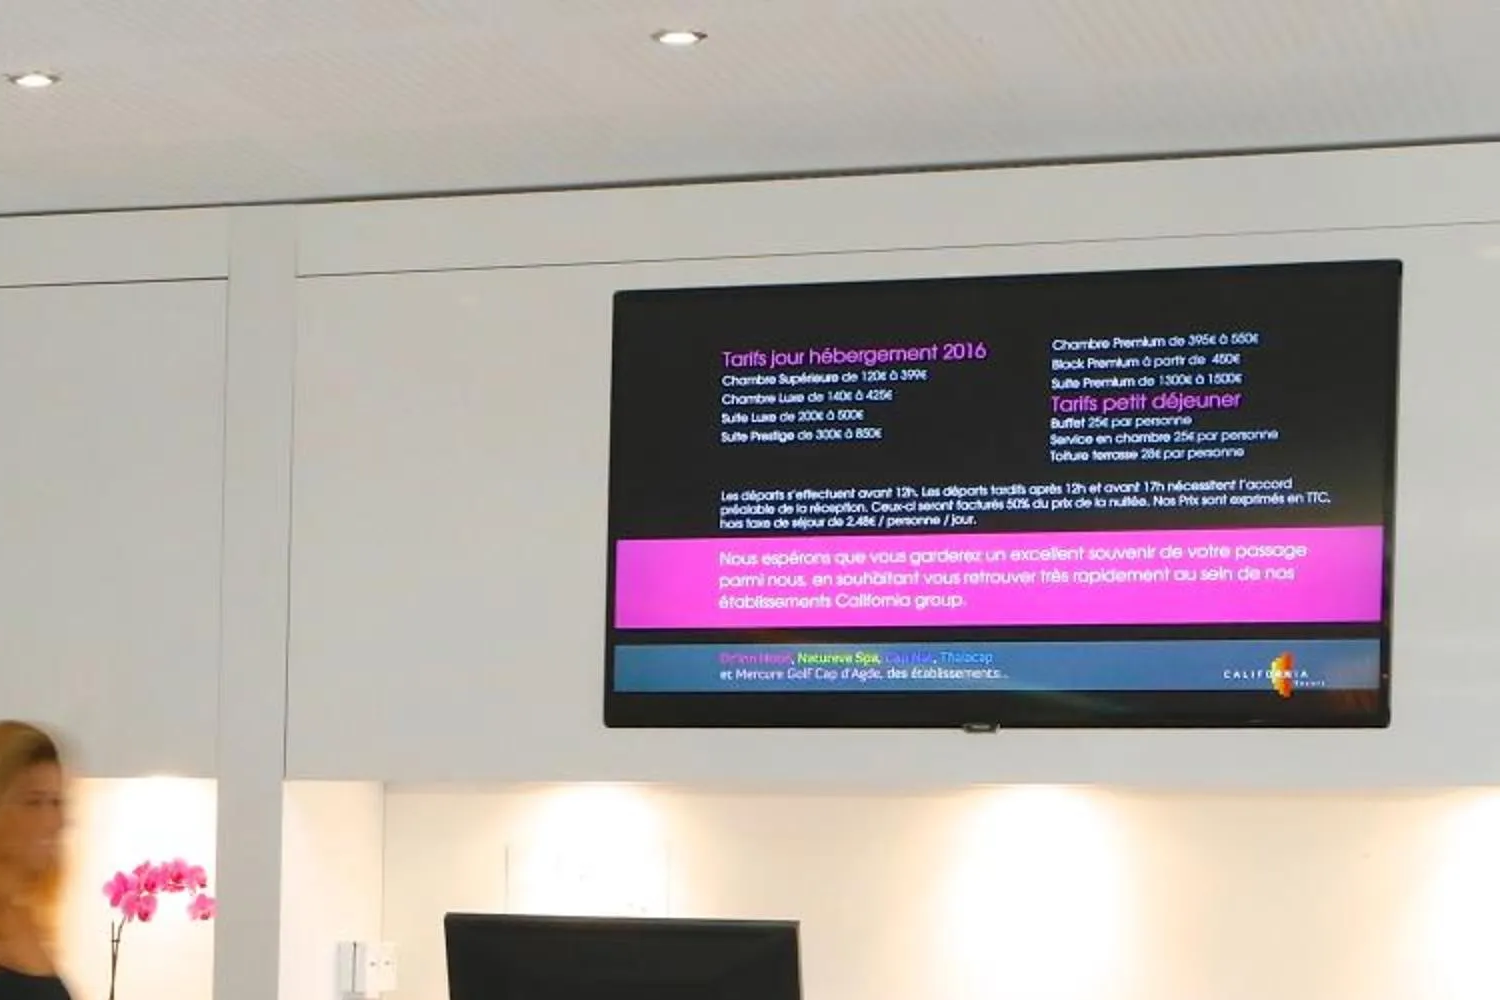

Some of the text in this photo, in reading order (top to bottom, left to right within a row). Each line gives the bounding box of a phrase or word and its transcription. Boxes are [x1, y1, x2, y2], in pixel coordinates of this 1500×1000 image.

[1052, 338, 1110, 351] Chambre
[1112, 336, 1166, 349] Premium
[1168, 335, 1185, 347] de
[1219, 333, 1228, 345] à
[723, 342, 987, 369] Tarifs jour hébergement 2016
[1087, 356, 1139, 369] Premium
[1142, 355, 1151, 368] à
[1153, 354, 1185, 369] partir
[1188, 353, 1206, 366] de
[721, 369, 928, 387] Chambre Supérieure de 120€ à 399€
[1051, 378, 1080, 390] Suite
[1082, 376, 1135, 388] Premium
[1138, 375, 1155, 387] de
[1195, 373, 1204, 385] à
[721, 393, 776, 405] Chambre
[778, 392, 804, 404] Luxe
[808, 391, 824, 403] de
[827, 390, 852, 402] 140€
[855, 389, 864, 401] à
[1052, 391, 1242, 414] Tarifs petit déjeuner
[721, 413, 748, 424] Suite
[751, 411, 776, 423] Luxe
[779, 411, 795, 422] de
[798, 410, 824, 422] 200€
[826, 409, 835, 421] à
[1051, 418, 1086, 429] Buffet
[1111, 418, 1132, 431] par
[1135, 416, 1192, 430] personne
[721, 427, 883, 444] Suite Prestige de 300€ à 850€
[1050, 434, 1093, 446] Service
[1096, 435, 1112, 445] en
[1115, 432, 1170, 444] chambre
[1197, 432, 1218, 445] par
[1221, 430, 1279, 444] personne
[1050, 450, 1089, 462] Toiture
[1092, 449, 1138, 460] terrasse
[1164, 449, 1186, 462] par
[1188, 448, 1245, 461] personne
[721, 490, 739, 502] Les
[741, 489, 785, 504] départs
[857, 487, 893, 499] avant
[921, 486, 940, 497] Les
[943, 485, 988, 499] départs
[990, 484, 1027, 497] tardifs
[1029, 482, 1063, 497] après
[1066, 482, 1087, 494] 12h
[1089, 482, 1102, 493] et
[1104, 481, 1140, 493] avant
[1144, 480, 1165, 492] 17h
[1239, 478, 1293, 491] l'accord
[720, 503, 775, 517] préalable
[777, 503, 794, 515] de
[796, 503, 806, 514] la
[871, 500, 916, 512] Ceux-ci
[918, 501, 953, 512] seront
[955, 499, 1004, 511] facturés
[1006, 498, 1031, 510] 50%
[1032, 498, 1049, 509] du
[1051, 497, 1072, 511] prix
[1074, 497, 1092, 508] de
[1094, 497, 1106, 508] la
[1153, 496, 1176, 507] Nos
[1178, 495, 1200, 506] Prix
[1201, 494, 1226, 506] sont
[1229, 493, 1284, 507] exprimés
[1287, 494, 1304, 504] en
[746, 517, 770, 528] taxe
[773, 517, 790, 528] de
[792, 515, 826, 530] séjour
[827, 515, 844, 527] de
[887, 515, 940, 529] personne
[951, 513, 977, 527] jour.
[719, 551, 757, 566] Nous
[762, 550, 831, 568] espérons
[835, 551, 867, 567] que
[869, 551, 906, 564] vous
[986, 549, 1006, 562] un
[1010, 545, 1085, 561] excellent
[1088, 546, 1157, 561] souvenir
[1160, 544, 1182, 559] de
[1188, 545, 1231, 559] votre
[1235, 544, 1308, 561] passage
[719, 573, 764, 589] parmi
[812, 574, 833, 586] en
[924, 572, 960, 585] vous
[963, 569, 1036, 584] retrouver
[1041, 568, 1069, 583] très
[1073, 567, 1169, 585] rapidement
[1174, 569, 1196, 582] au
[1200, 567, 1232, 581] sein
[1237, 566, 1260, 581] de
[1264, 567, 1295, 580] nos
[719, 594, 832, 609] établissements
[835, 592, 911, 608] California
[720, 669, 733, 680] et
[736, 668, 785, 680] Mercure
[787, 668, 814, 680] Golf
[815, 668, 838, 681] Cap
[888, 667, 908, 679] des
[1223, 669, 1309, 679] CALIFORNIA
